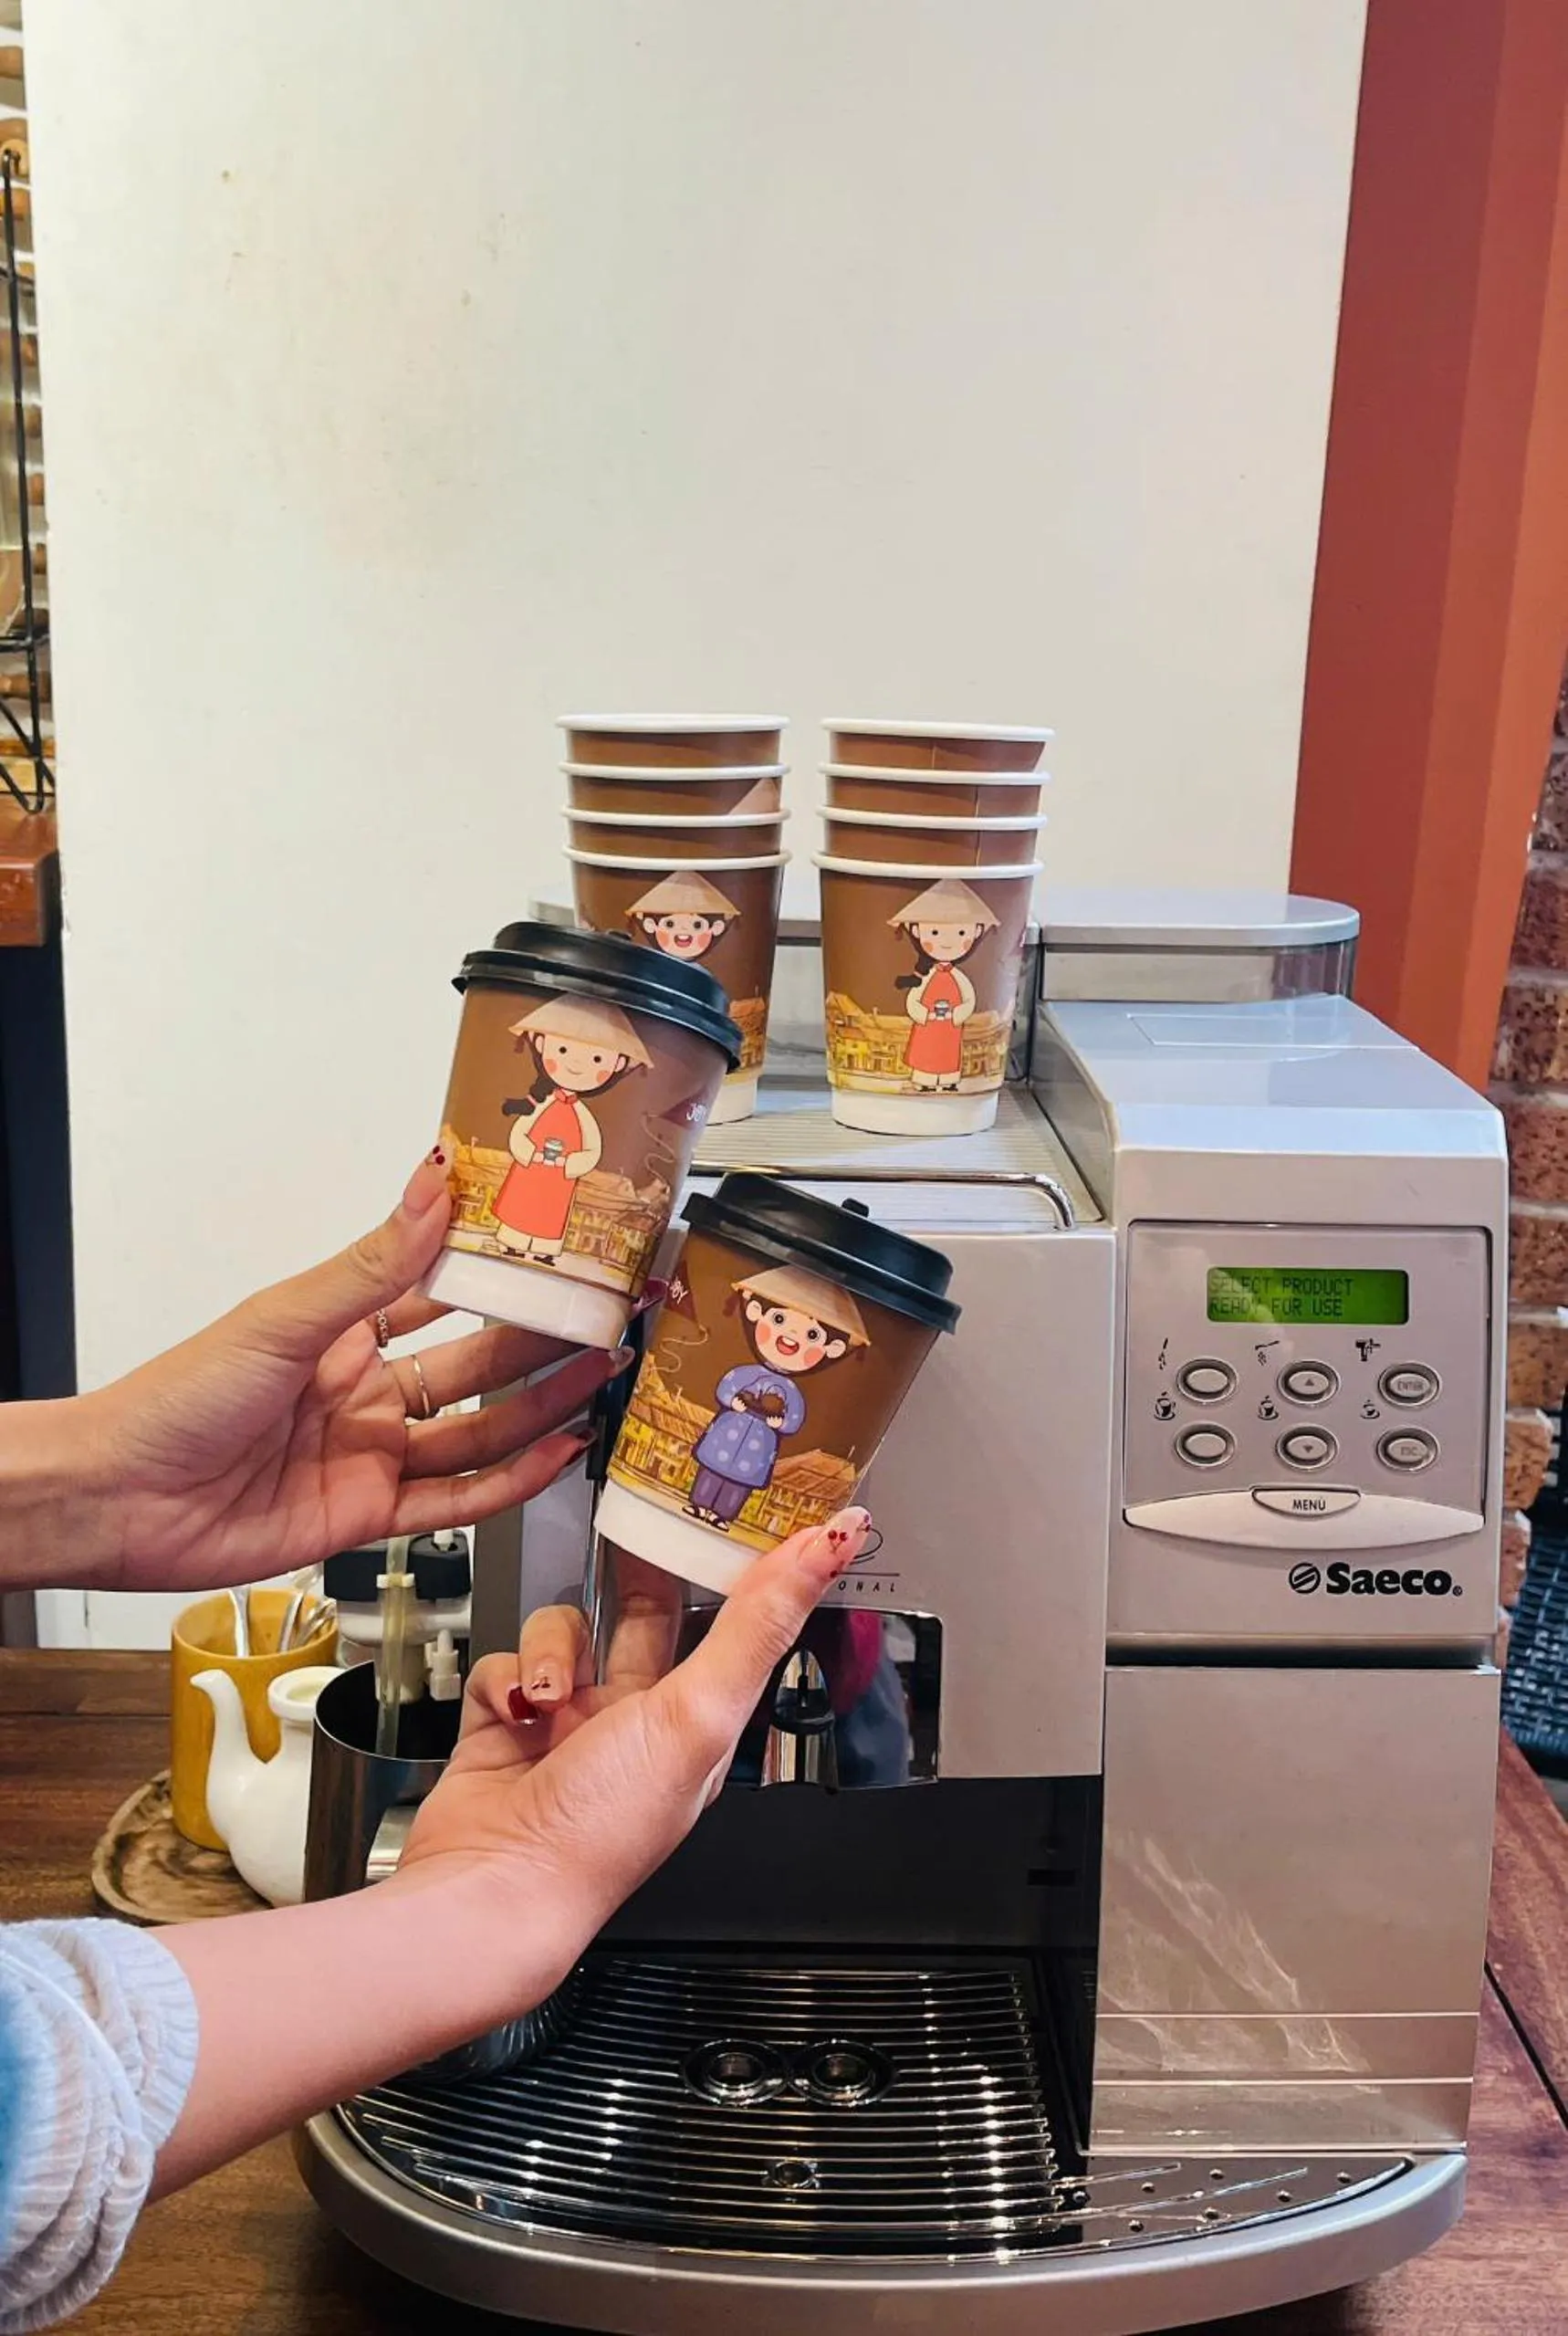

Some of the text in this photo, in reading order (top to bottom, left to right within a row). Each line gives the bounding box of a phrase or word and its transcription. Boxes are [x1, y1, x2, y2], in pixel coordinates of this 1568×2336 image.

[1207, 1276, 1354, 1296] SELECT PRODUCT
[1209, 1296, 1343, 1317] READY FOR USE
[838, 1580, 895, 1593] ONAL
